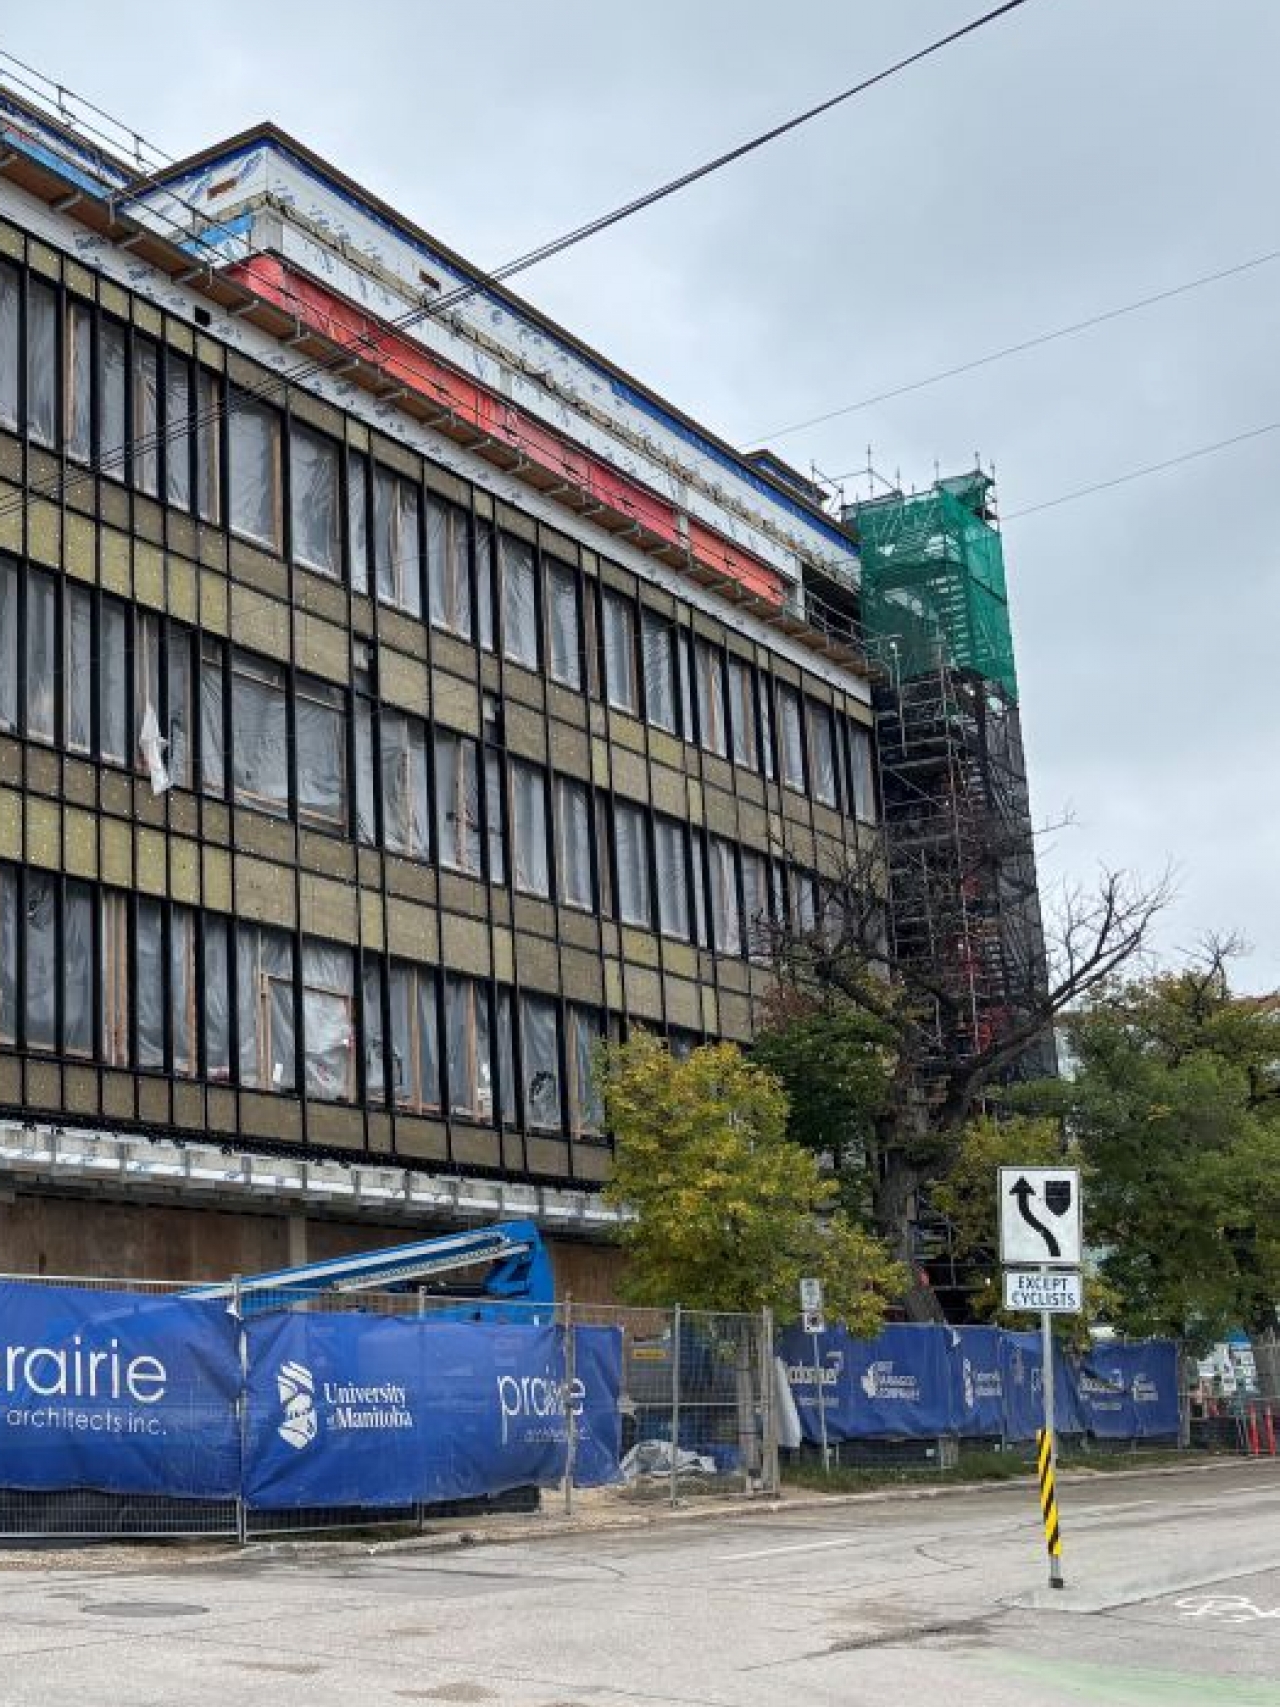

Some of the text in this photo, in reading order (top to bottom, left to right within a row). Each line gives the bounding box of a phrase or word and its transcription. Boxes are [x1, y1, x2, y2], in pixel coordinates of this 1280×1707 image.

[1018, 1275, 1068, 1291] EXCEPT
[1011, 1291, 1075, 1307] CYCLISTS
[323, 1382, 406, 1408] University
[6, 1406, 167, 1435] architects inc.
[336, 1405, 413, 1428] Manitoba
